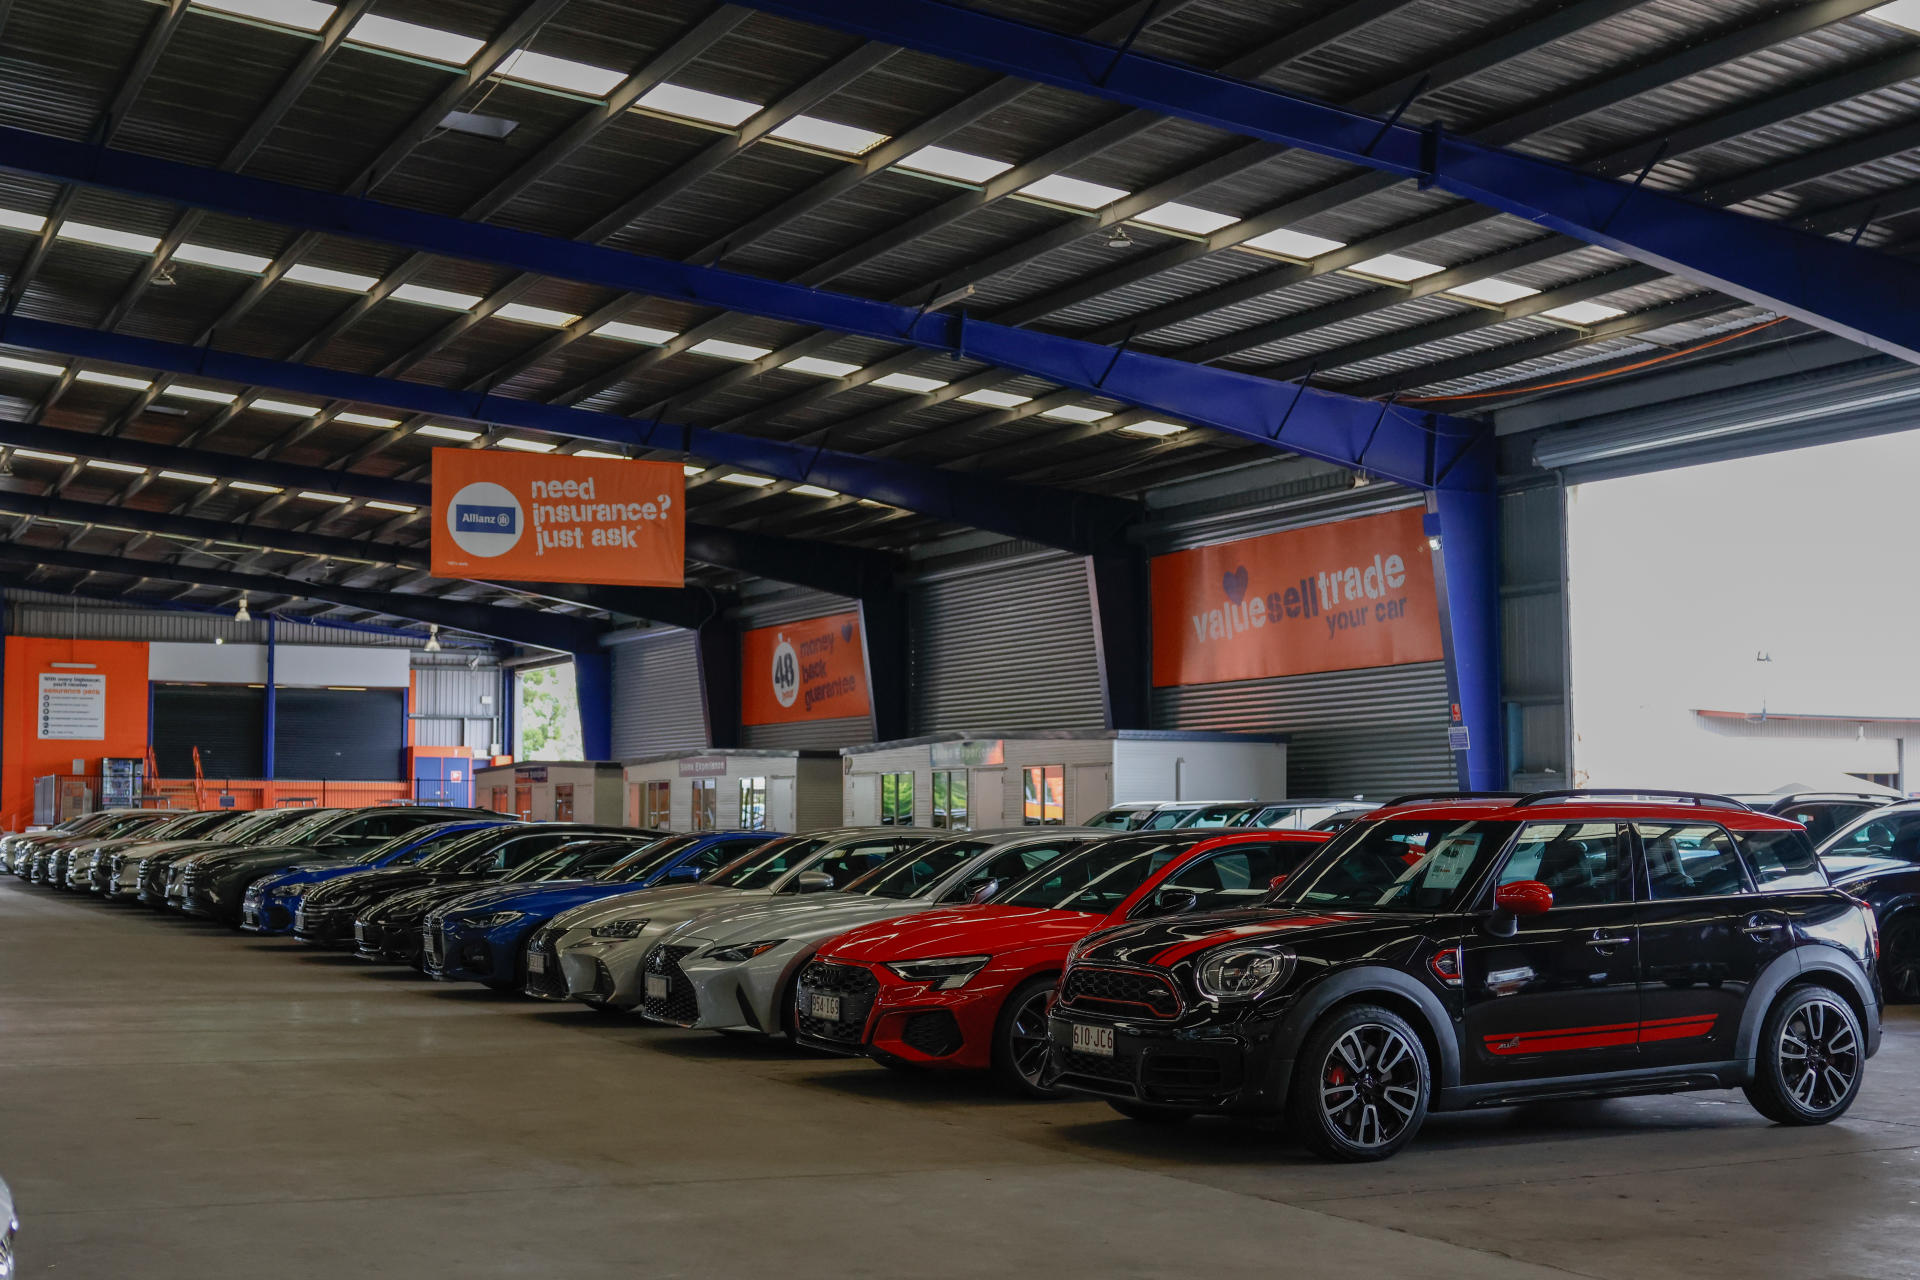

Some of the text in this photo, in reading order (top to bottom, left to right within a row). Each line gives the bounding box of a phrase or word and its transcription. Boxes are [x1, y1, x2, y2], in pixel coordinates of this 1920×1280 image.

[531, 477, 596, 500] need
[462, 512, 496, 525] Allianz
[532, 494, 672, 526] insurance?
[535, 527, 585, 556] just
[1326, 597, 1408, 640] your car
[800, 632, 835, 658] money
[775, 652, 795, 689] 48
[802, 659, 827, 684] back
[804, 675, 856, 712] guarantee
